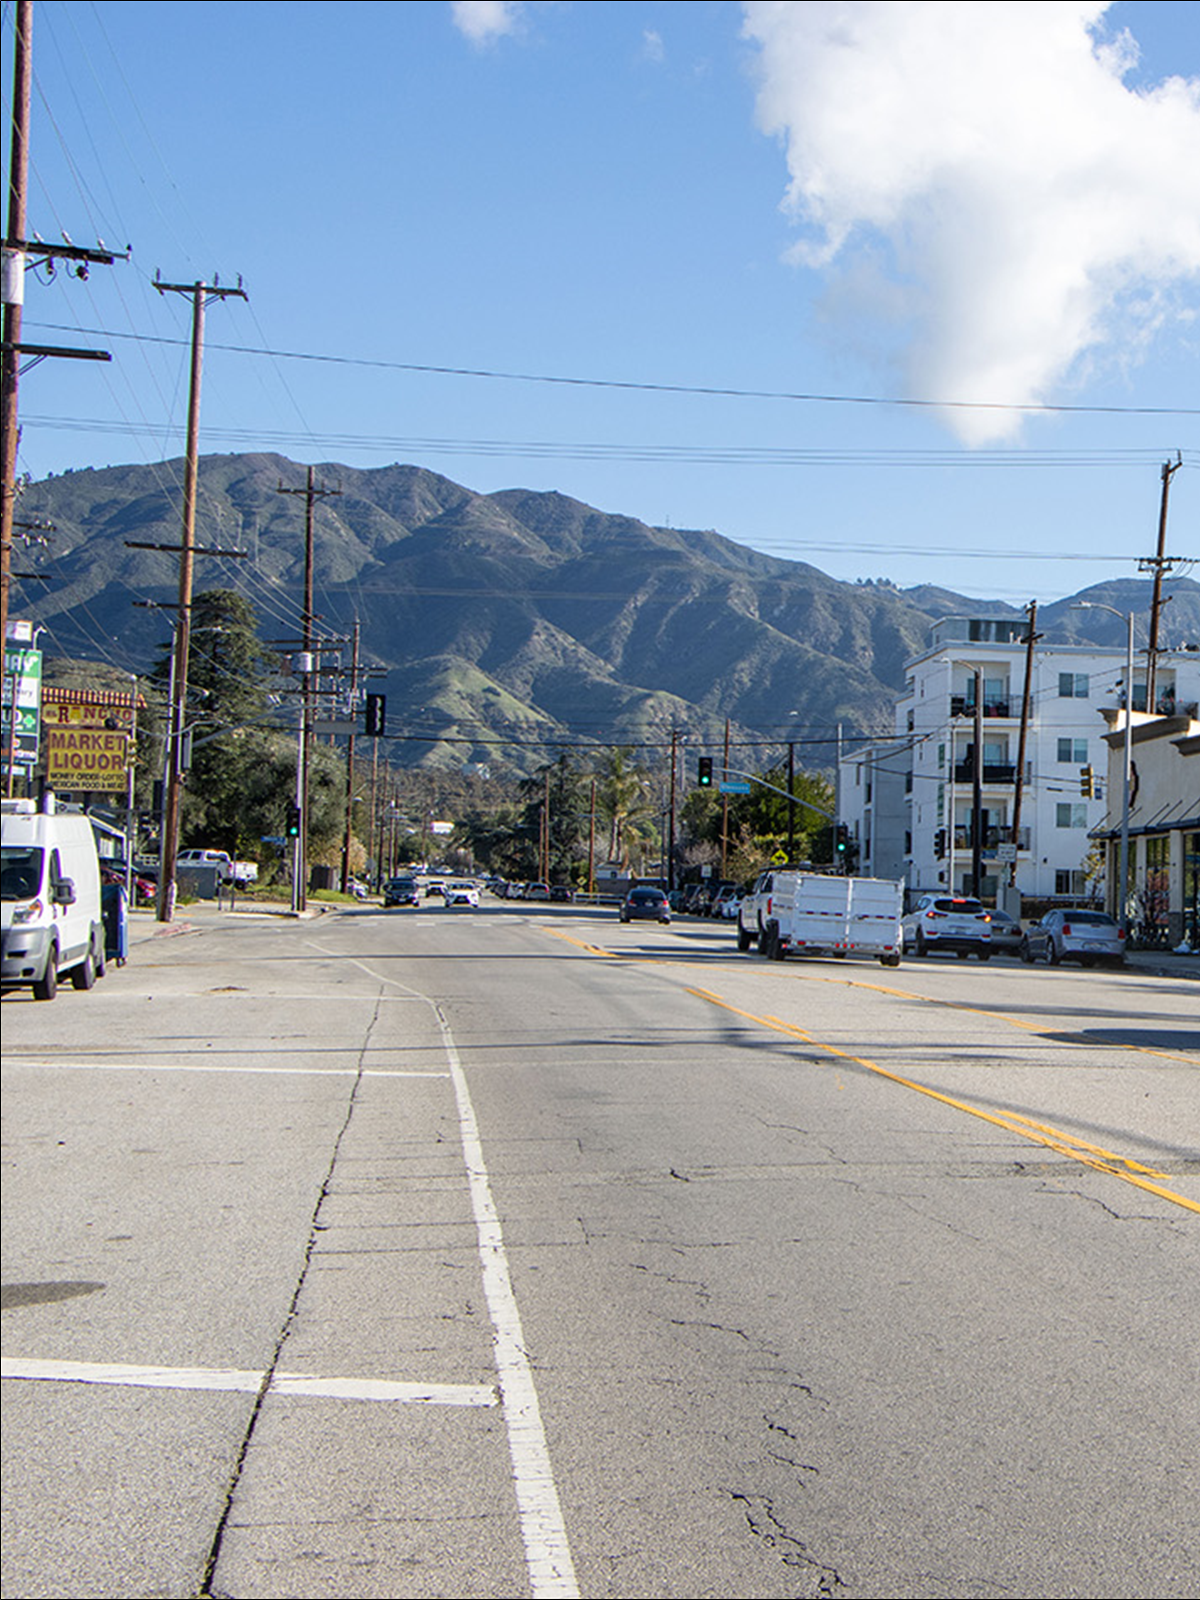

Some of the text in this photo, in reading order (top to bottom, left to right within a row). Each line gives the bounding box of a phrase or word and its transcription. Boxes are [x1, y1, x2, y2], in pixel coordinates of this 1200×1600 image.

[52, 732, 125, 751] MARKET
[53, 752, 122, 770] LIQUOR
[50, 772, 75, 780] MONEY
[81, 781, 100, 789] FOOD
